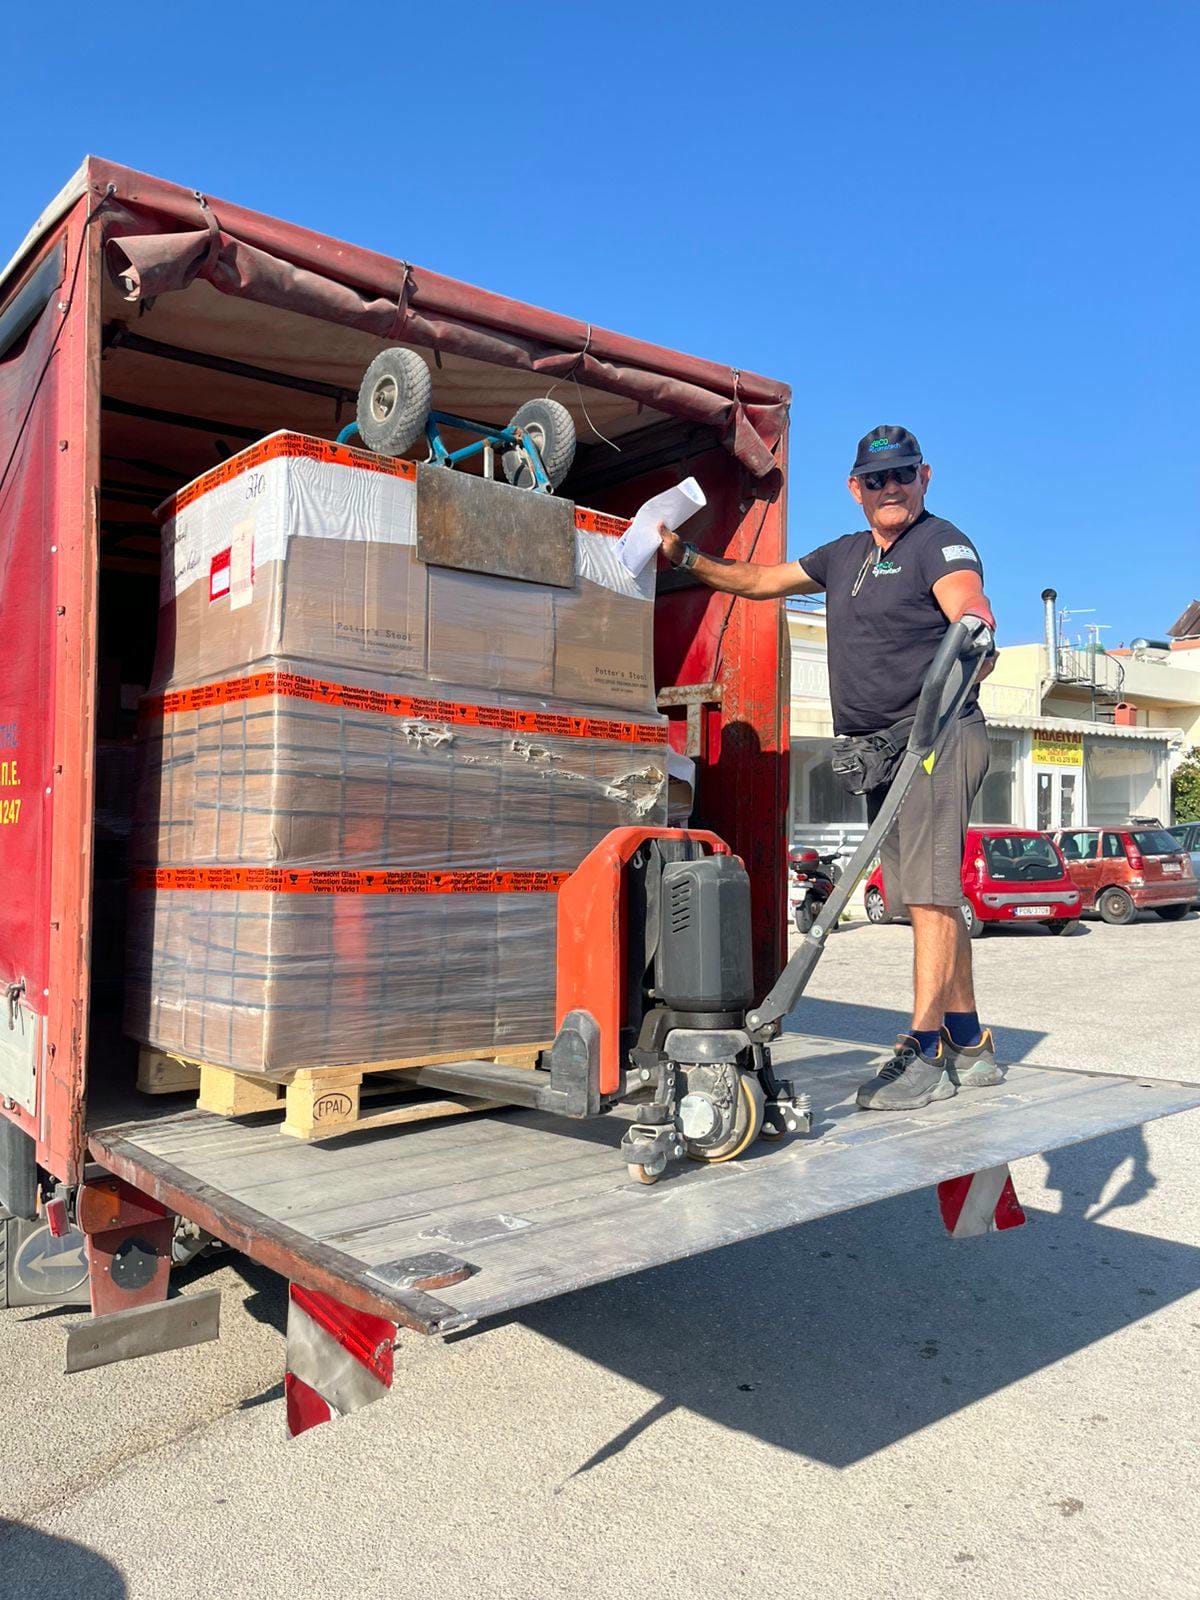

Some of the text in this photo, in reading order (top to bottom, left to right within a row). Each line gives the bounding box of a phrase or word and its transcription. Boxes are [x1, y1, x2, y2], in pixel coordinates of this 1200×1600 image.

[386, 630, 412, 642] Stool
[267, 672, 294, 682] Voicht
[629, 671, 648, 680] Stool
[266, 680, 293, 688] Attion
[1034, 730, 1082, 744] ΠΩΛΕΙΤΑΙ
